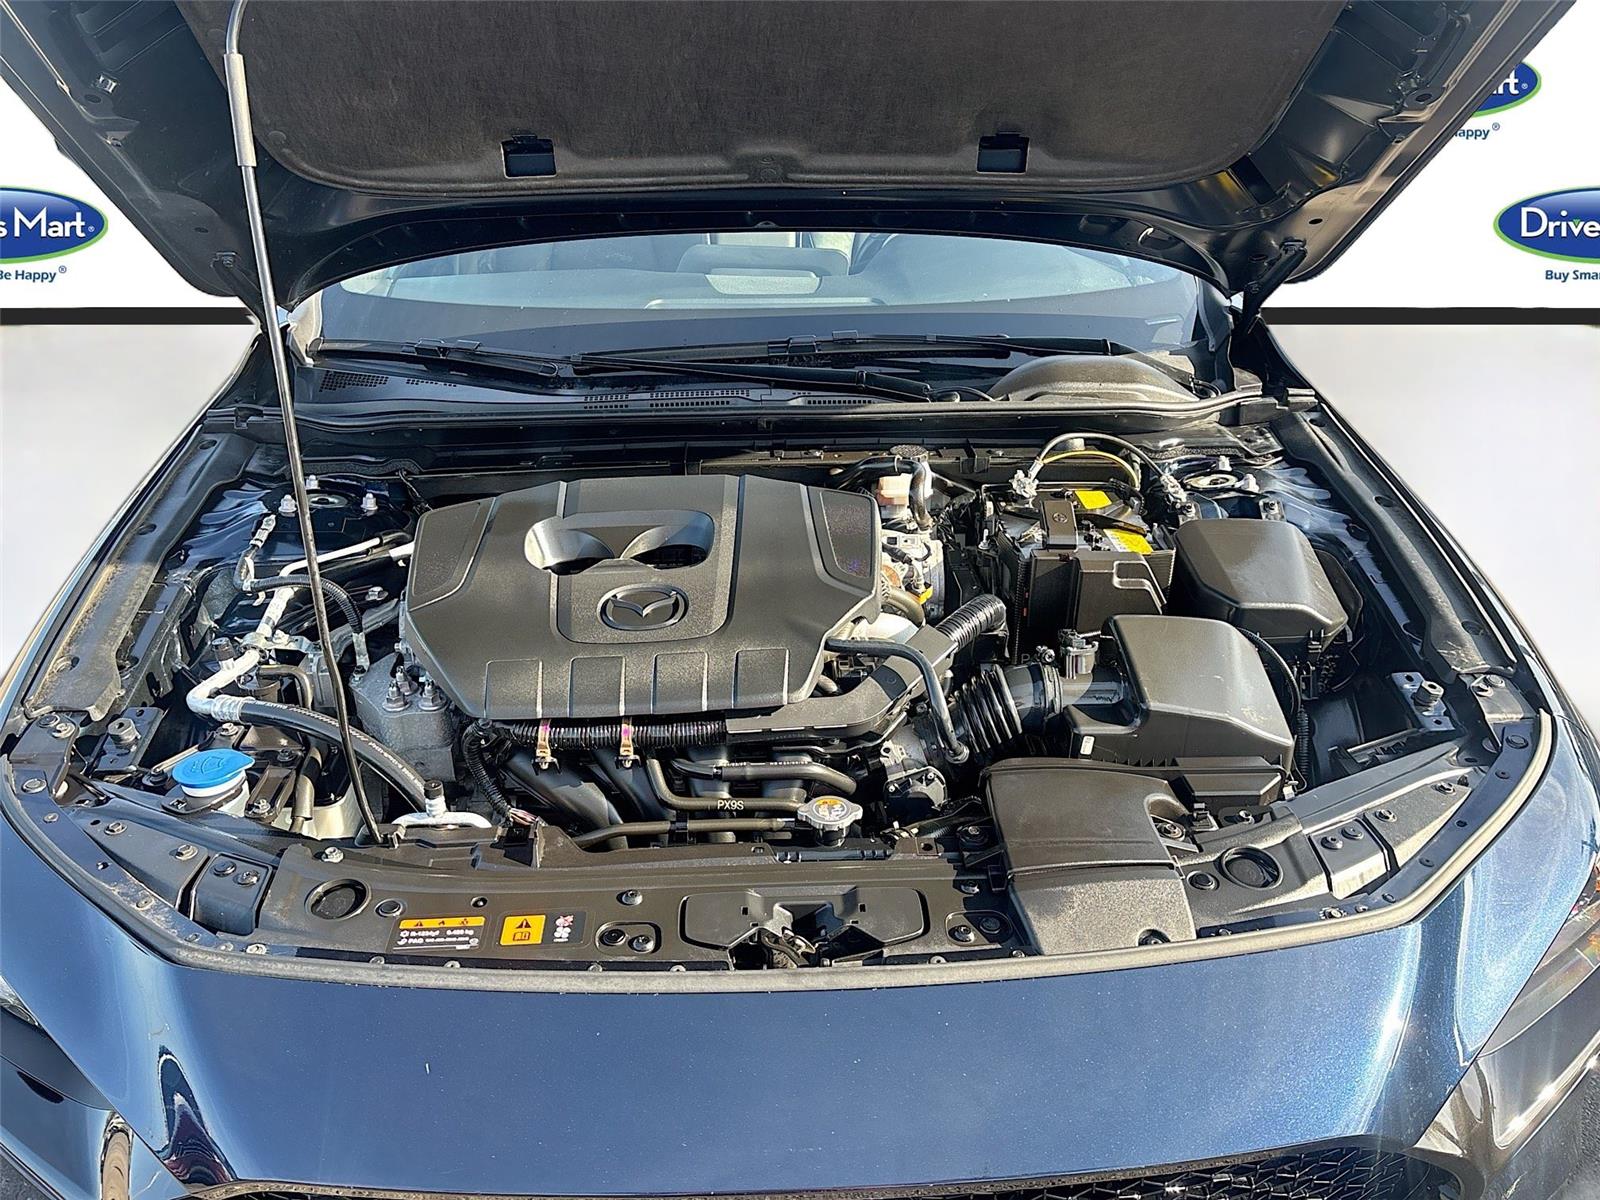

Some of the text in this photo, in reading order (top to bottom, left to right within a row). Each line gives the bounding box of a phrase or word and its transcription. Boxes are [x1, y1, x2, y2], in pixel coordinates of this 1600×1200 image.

[1455, 129, 1490, 140] appy
[13, 206, 86, 238] Mart
[1520, 206, 1600, 238] Drive
[15, 269, 57, 283] Happy
[1545, 269, 1600, 283] Buy Sma
[717, 799, 745, 811] PX9S
